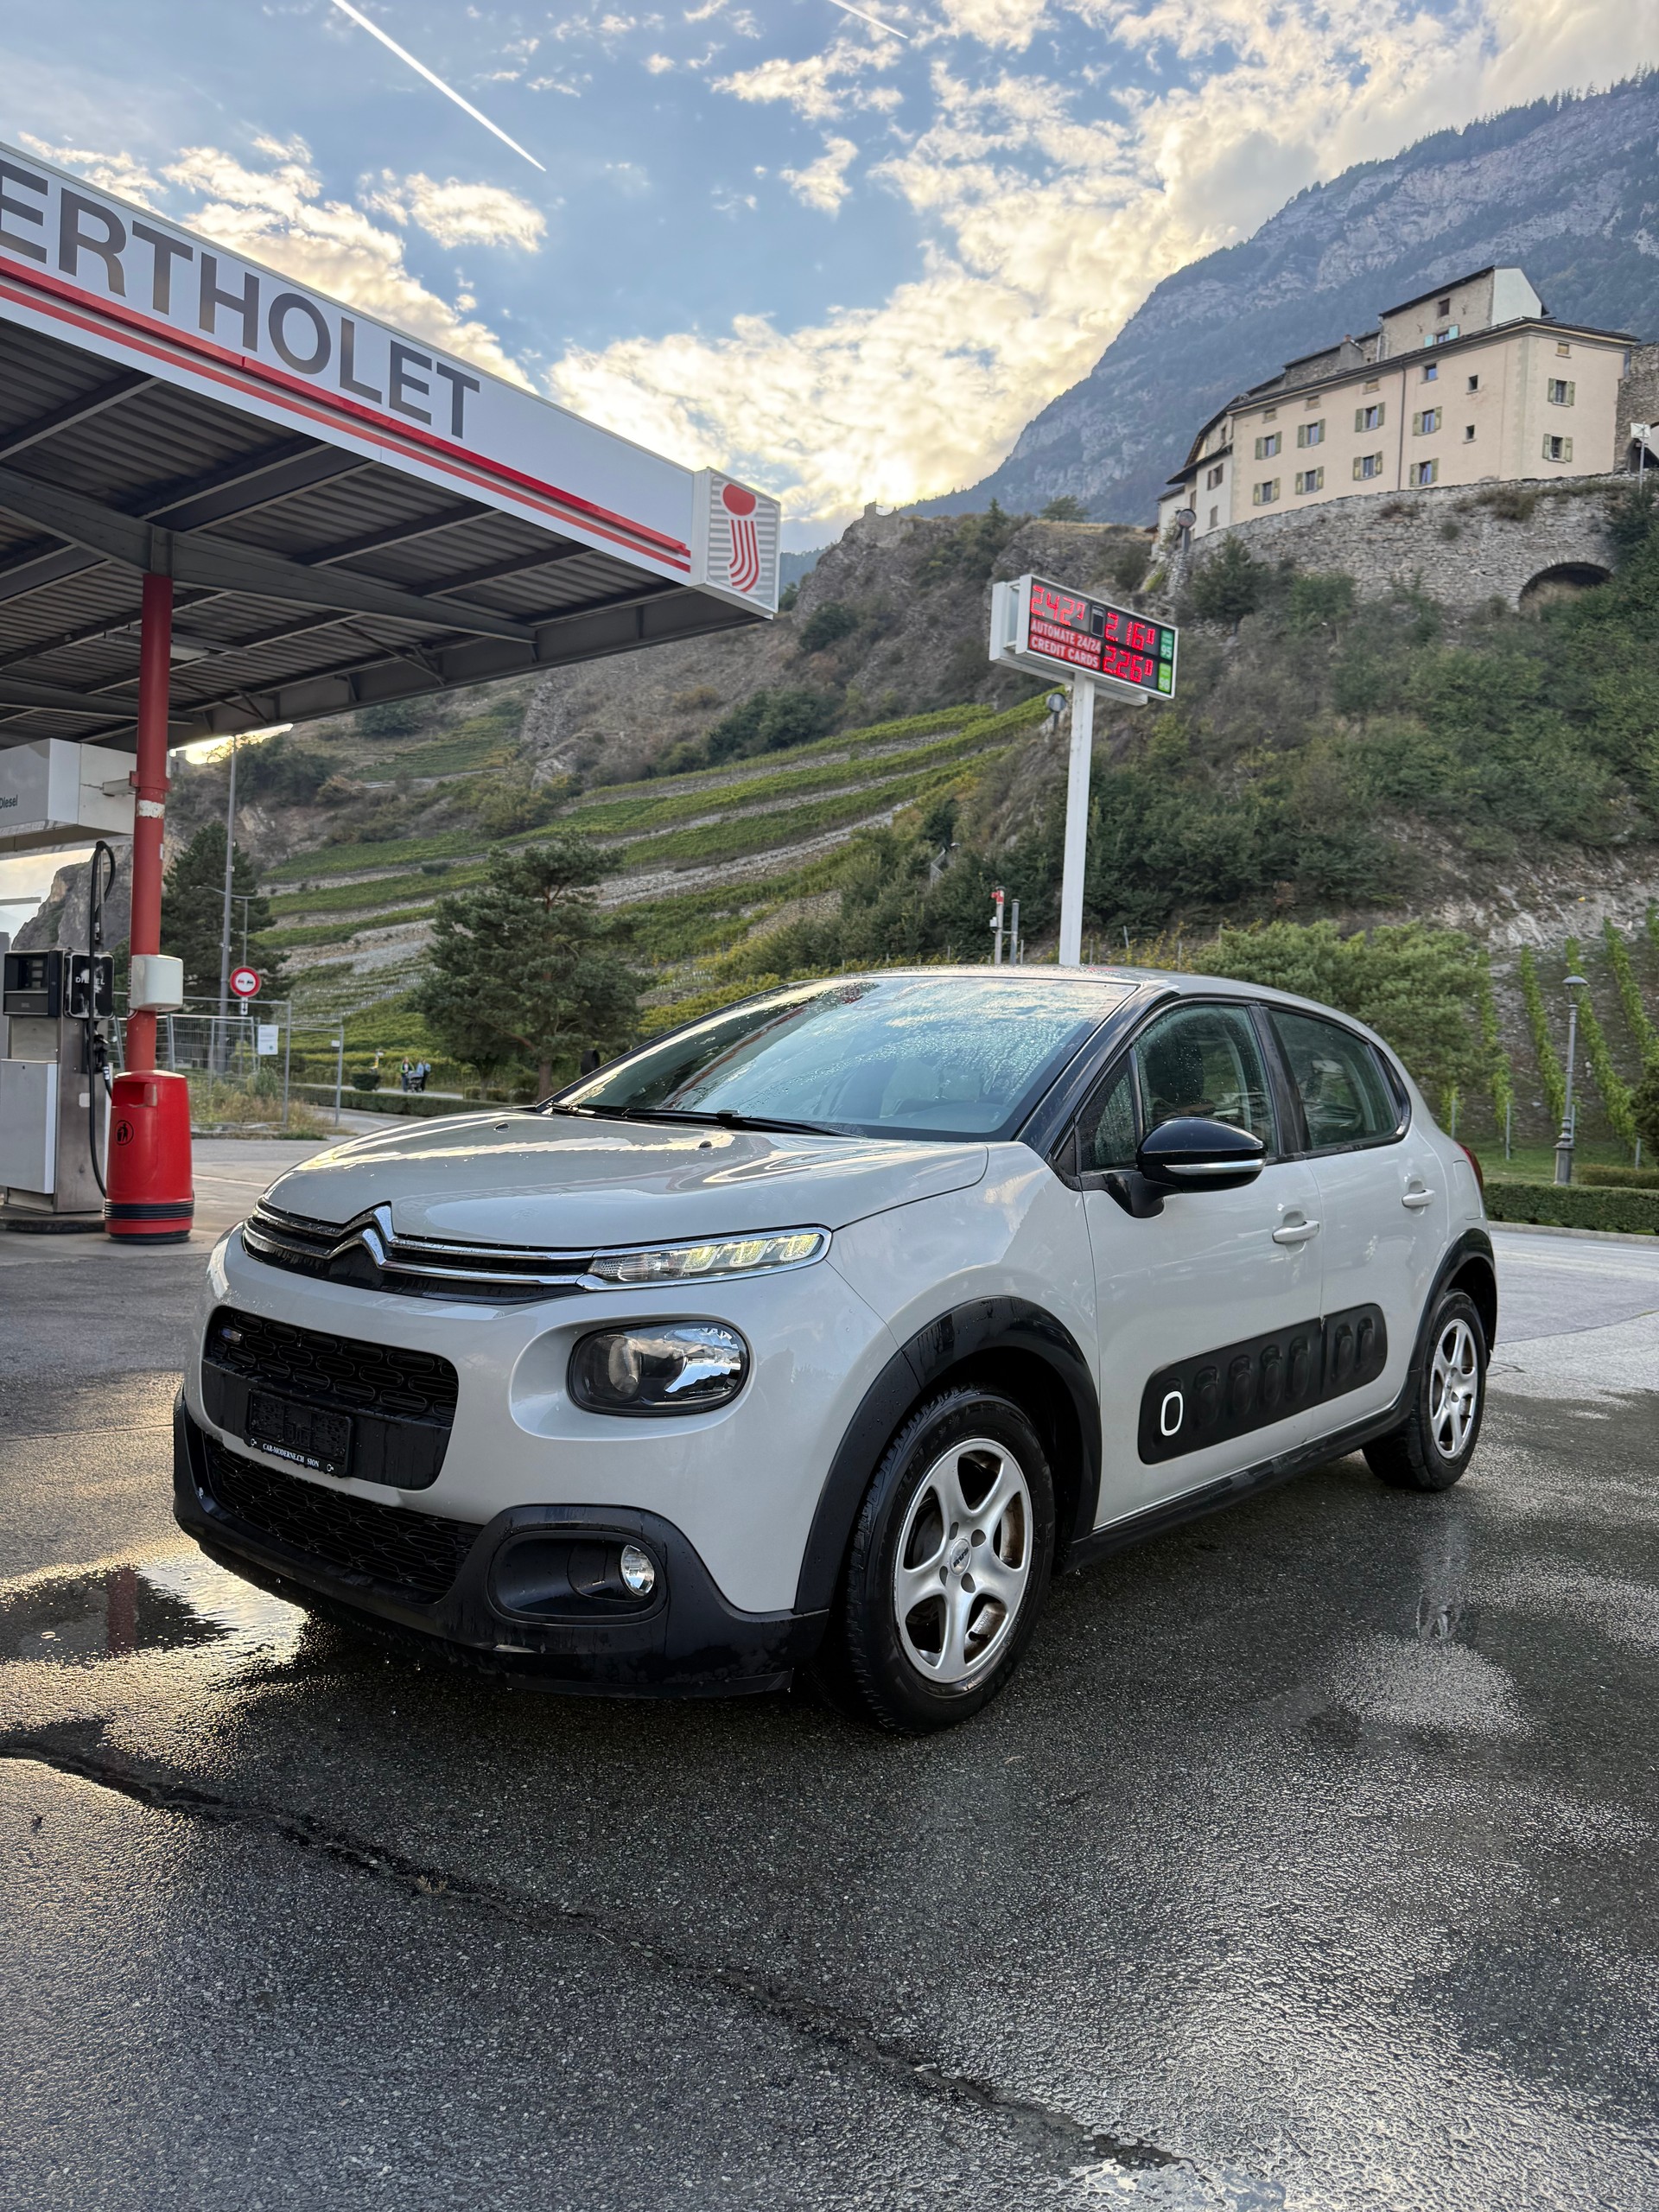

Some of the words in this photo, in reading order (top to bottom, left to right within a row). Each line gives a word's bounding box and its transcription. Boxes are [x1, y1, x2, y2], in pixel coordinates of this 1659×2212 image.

[0, 158, 480, 440] ERTHOLET
[1030, 620, 1076, 645] AUTOMATE
[1076, 634, 1102, 654] 24/24
[1031, 636, 1066, 658] CREDIT
[1067, 648, 1099, 670] CARDS
[1160, 645, 1173, 659] 95
[0, 794, 18, 810] Diesel
[75, 976, 105, 986] DIEL
[307, 1458, 320, 1468] SION
